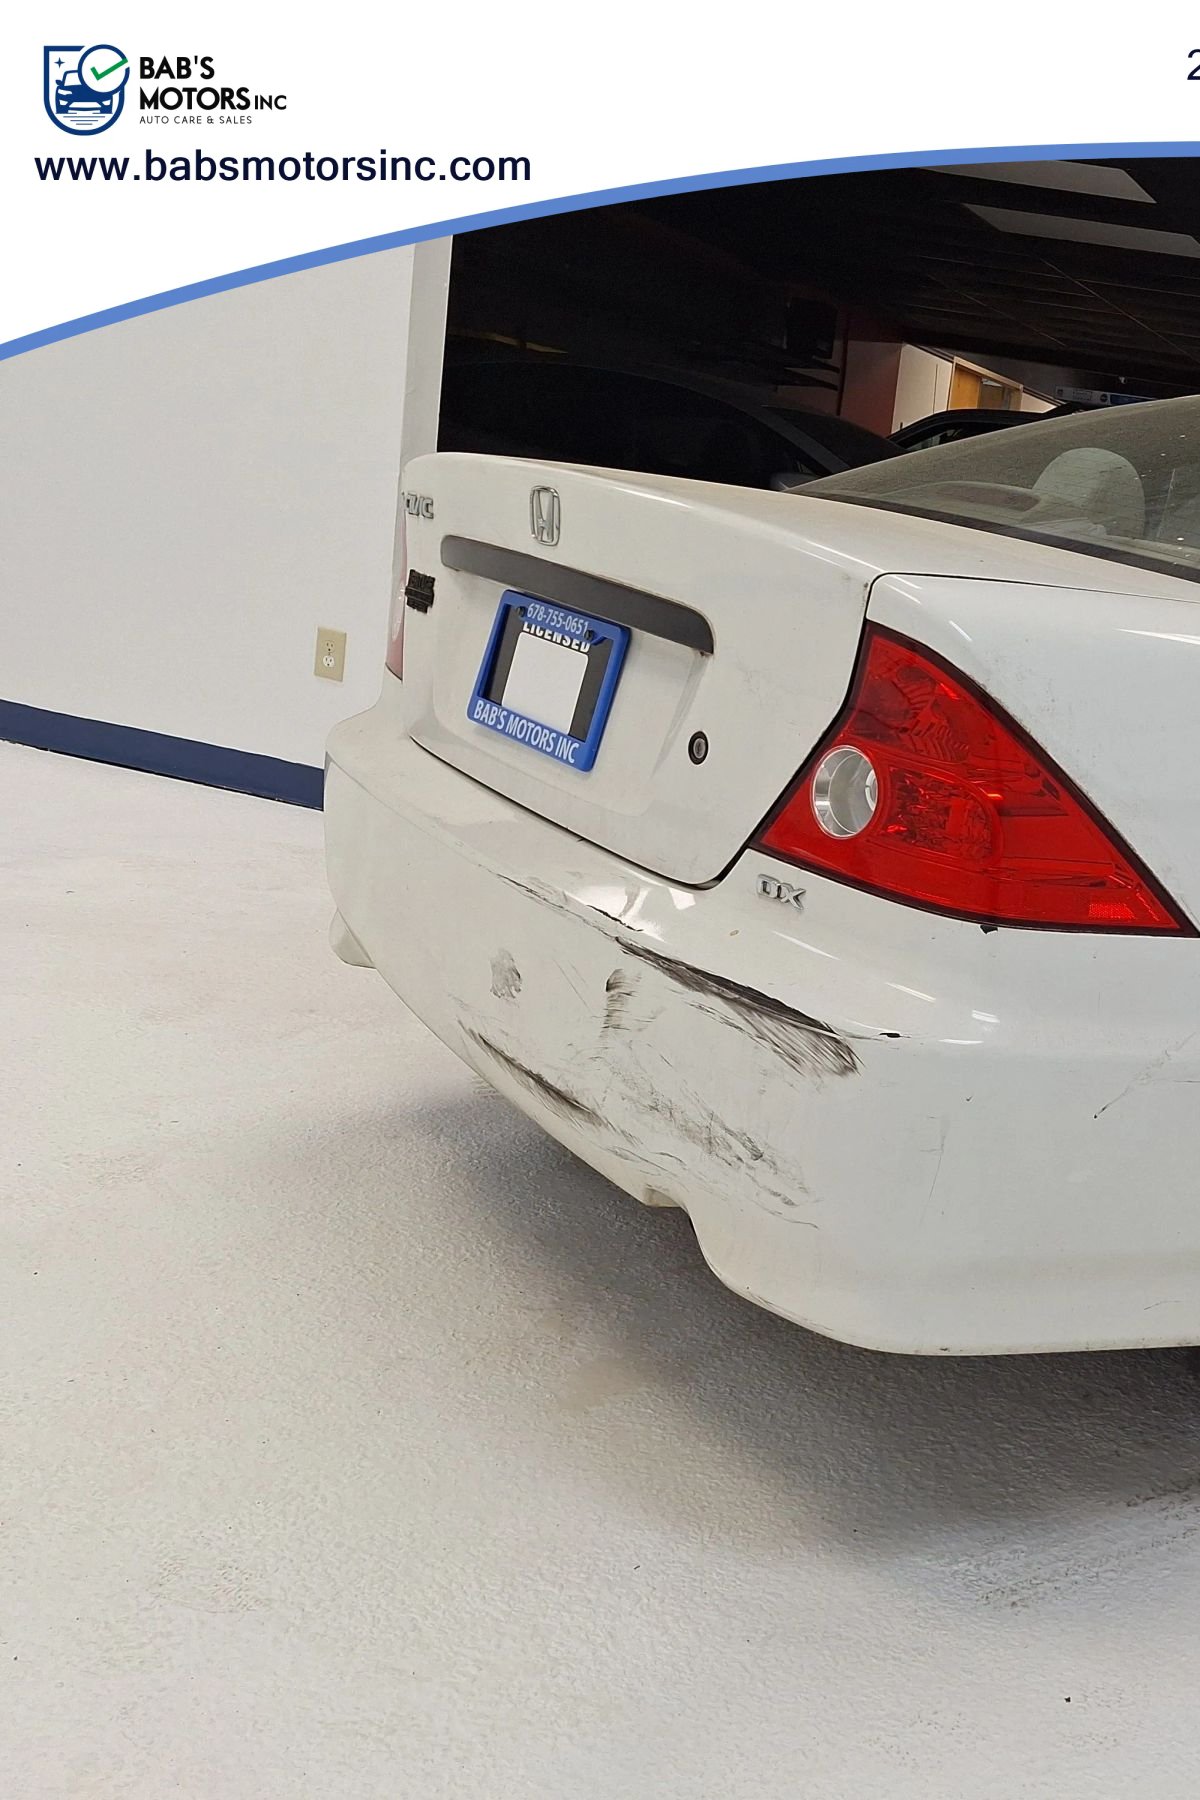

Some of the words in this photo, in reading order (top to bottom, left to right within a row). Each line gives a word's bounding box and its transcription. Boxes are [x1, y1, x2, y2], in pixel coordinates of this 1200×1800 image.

[527, 603, 588, 637] 678-755-0651
[473, 699, 507, 730] BAB'S
[505, 714, 557, 753] MOTORS
[555, 736, 580, 764] INC
[756, 873, 806, 911] DX
